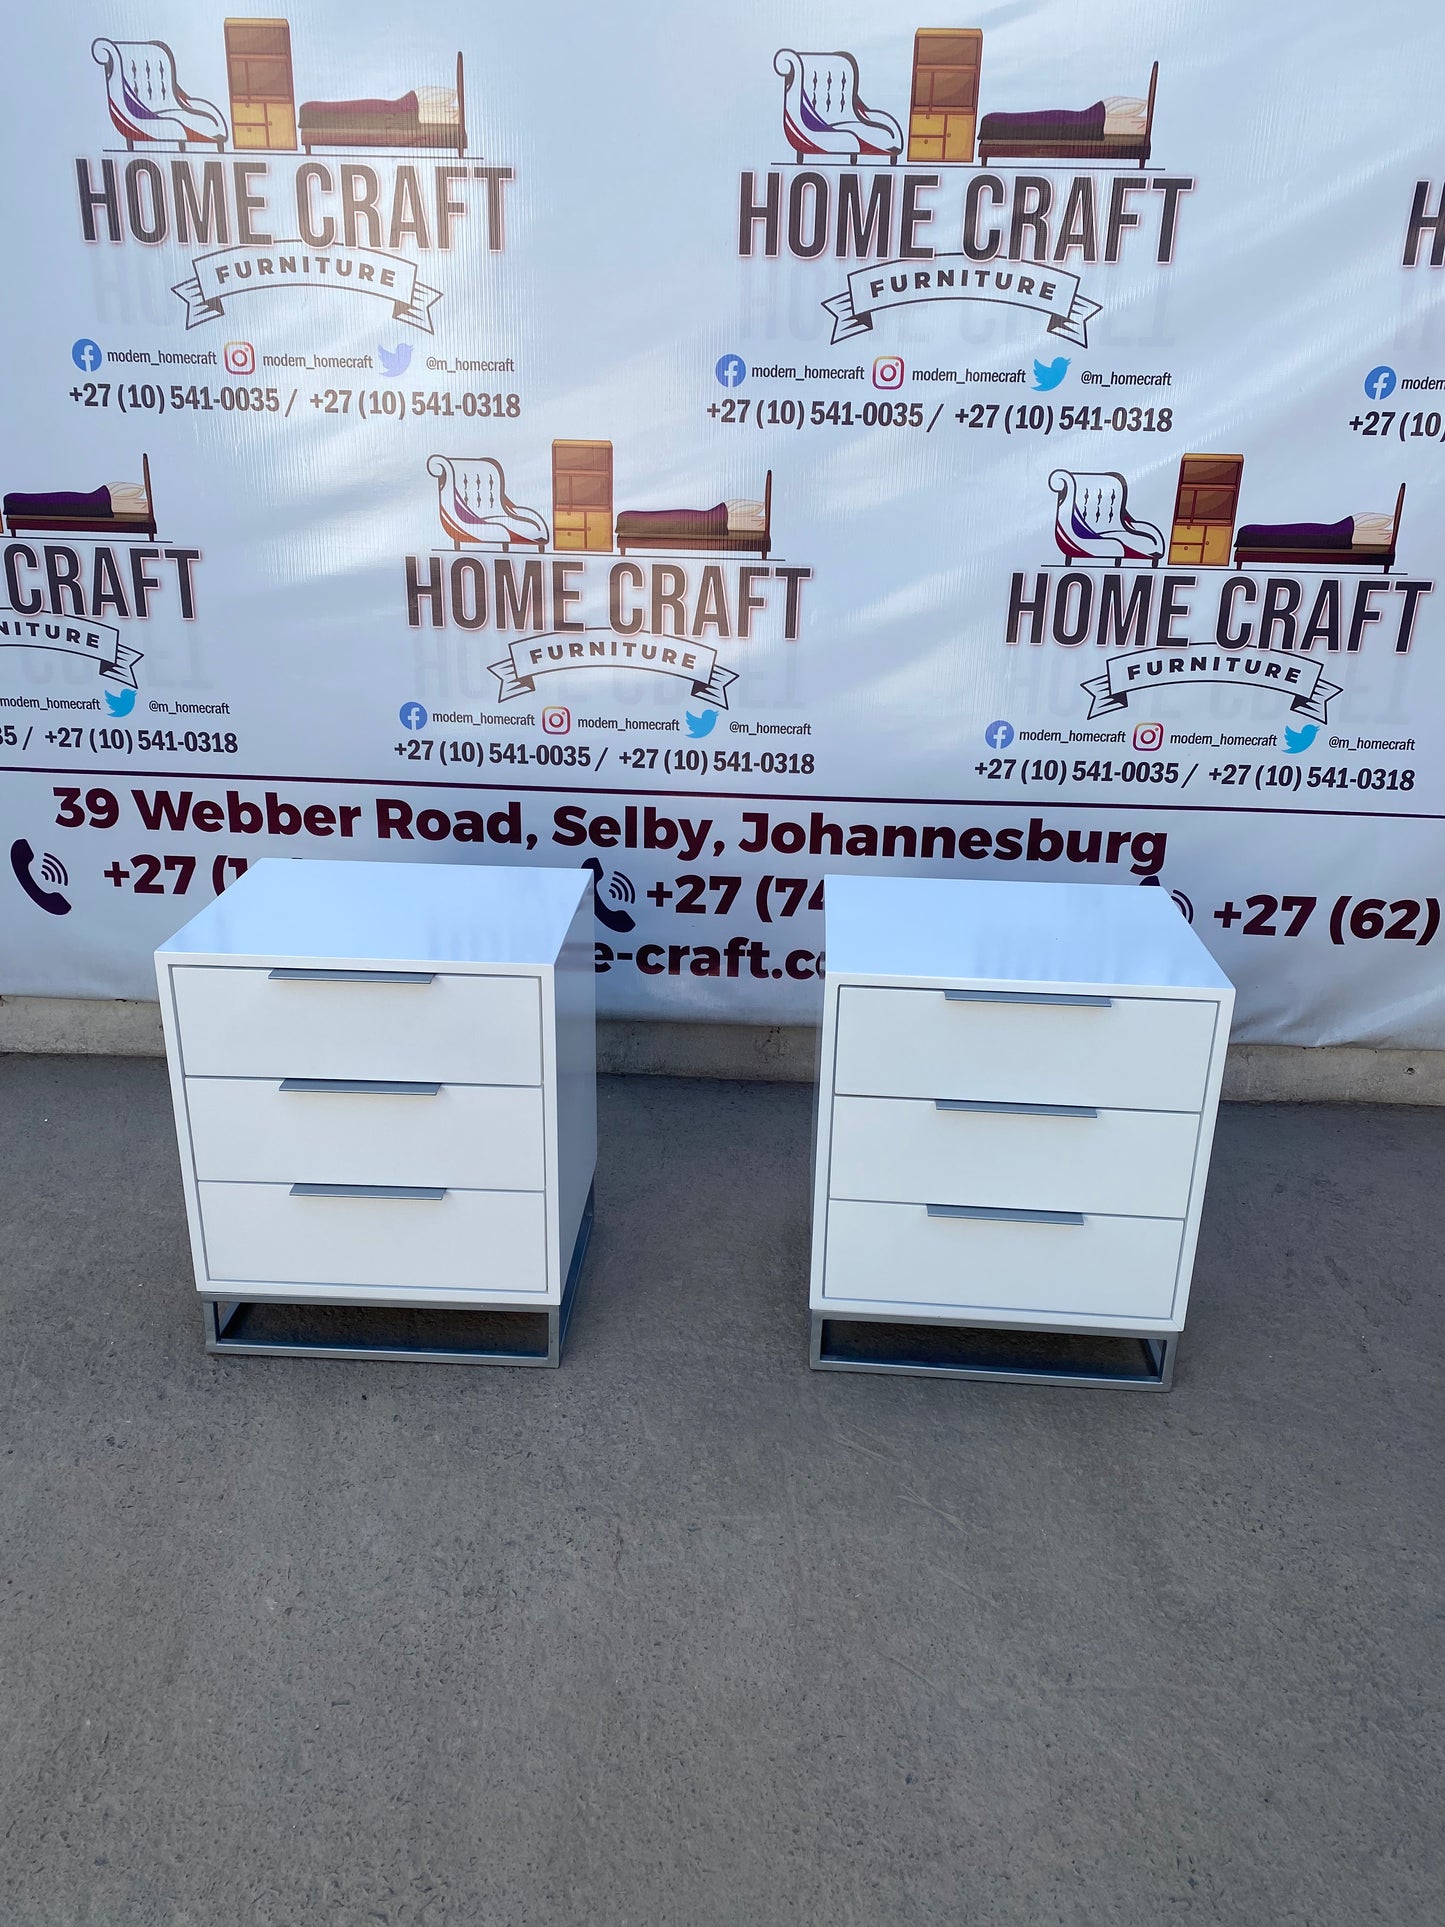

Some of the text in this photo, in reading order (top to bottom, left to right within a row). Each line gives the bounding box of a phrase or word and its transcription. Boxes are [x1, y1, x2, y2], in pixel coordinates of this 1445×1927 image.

[75, 158, 513, 252] HOME CRAFT
[737, 172, 1193, 264] HOME CRAFT
[215, 256, 395, 287] FURNITURE
[870, 270, 1056, 301] FURNITURE
[107, 349, 514, 373] modern_homecraft modern_homecraft @m_homecraft
[752, 364, 1172, 387] modern_homecraft modern_homecraft @m_homecraft
[69, 383, 110, 407] +27
[118, 384, 164, 414] (10)
[171, 385, 279, 412] 541-0035
[310, 389, 352, 413] +27
[359, 391, 405, 420] (10)
[412, 392, 520, 418] 541-0318
[707, 399, 750, 423] +27
[757, 400, 804, 430] (10)
[810, 401, 923, 427] 541-0035
[955, 404, 1000, 428] +27
[1005, 405, 1053, 435] (10)
[1059, 406, 1173, 432] 541-0318
[1349, 411, 1396, 436] +27
[3, 543, 201, 620] CRAFT
[406, 556, 812, 640] HOME CRAFT
[1005, 572, 1433, 654] HOME CRAFT
[530, 642, 696, 669] FURNITURE
[1127, 657, 1301, 684] FURNITURE
[0, 696, 230, 715] modern_homecraft @m_homecraft
[45, 727, 83, 748] +27
[90, 728, 133, 754] (10)
[138, 730, 238, 753] 541-0318
[433, 712, 811, 735] modern_homecraft modern_homecraft @m_homecraft
[1019, 729, 1415, 751] modern_homecraft modern_homecraft @m_homecraft
[394, 739, 433, 760] +27
[440, 741, 483, 767] (10)
[489, 743, 591, 767] 541-0035
[619, 748, 658, 769] +27
[664, 749, 708, 775] (10)
[713, 751, 814, 774] 541-0318
[975, 759, 1016, 779] +27
[1021, 760, 1067, 785] (10)
[1072, 761, 1179, 783] 541-0035
[1209, 764, 1251, 785] +27
[1255, 765, 1301, 791] (10)
[1307, 767, 1415, 791] 541-0318
[53, 787, 1168, 876] 39 Webber Road, Selby, Johannesburg
[104, 854, 196, 895] +27
[647, 875, 741, 914] +27
[1214, 894, 1440, 946] +27 (62)
